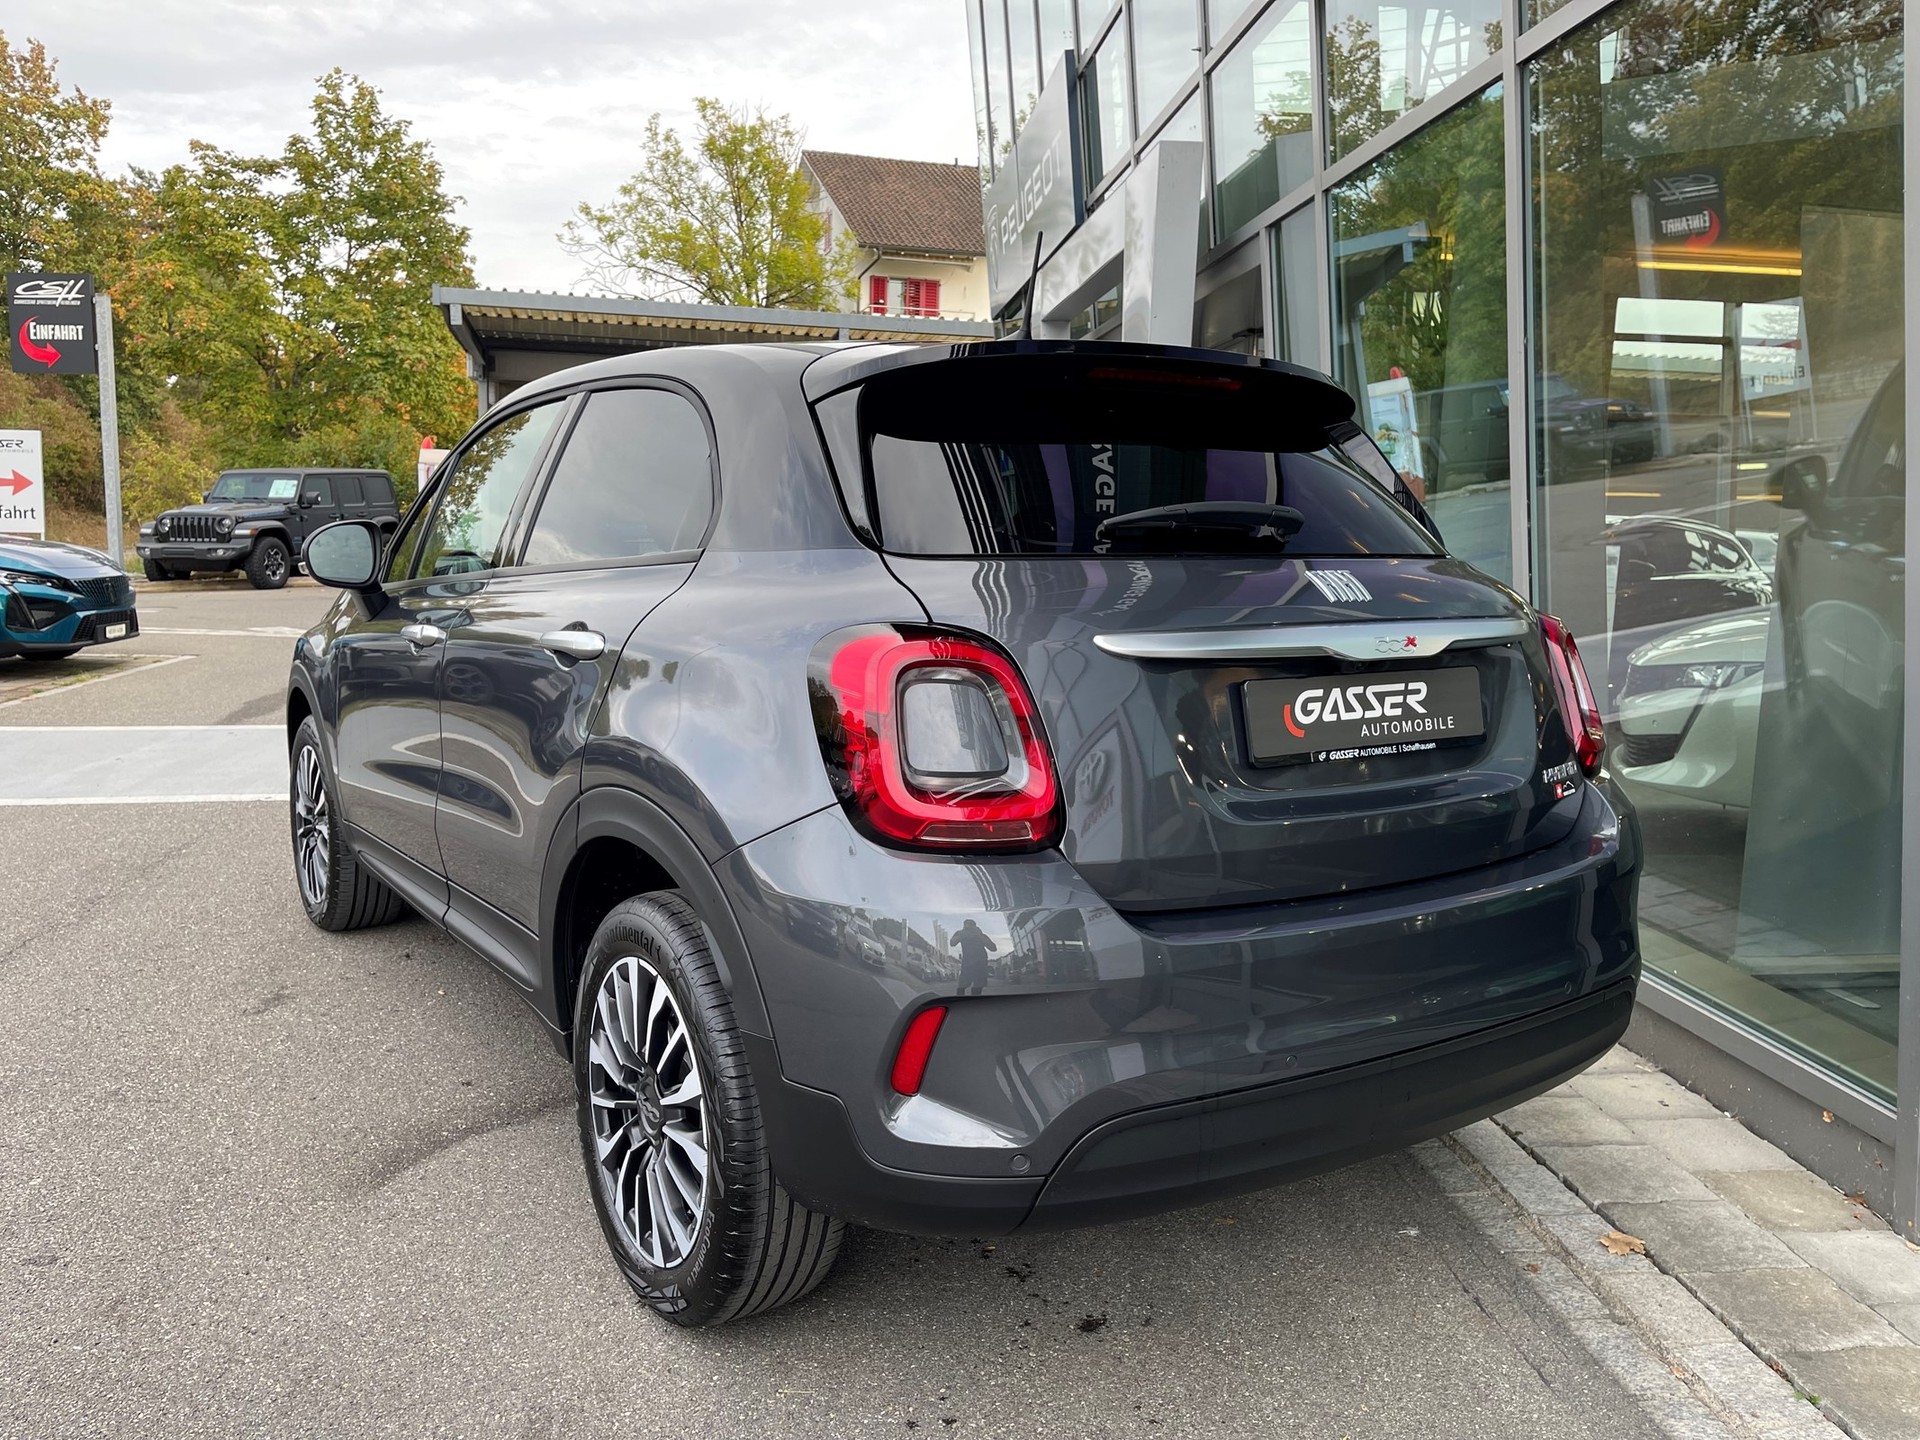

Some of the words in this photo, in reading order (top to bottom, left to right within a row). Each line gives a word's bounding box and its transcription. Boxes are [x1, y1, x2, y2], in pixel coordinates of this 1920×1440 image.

[1001, 130, 1062, 255] PEUGEOT
[1294, 681, 1428, 725] GASSER
[1360, 715, 1455, 738] AUTOMOBILE
[1329, 749, 1359, 760] GASSER
[1360, 745, 1398, 757] AUTOMOBILE
[1402, 742, 1436, 752] Schaffhausen
